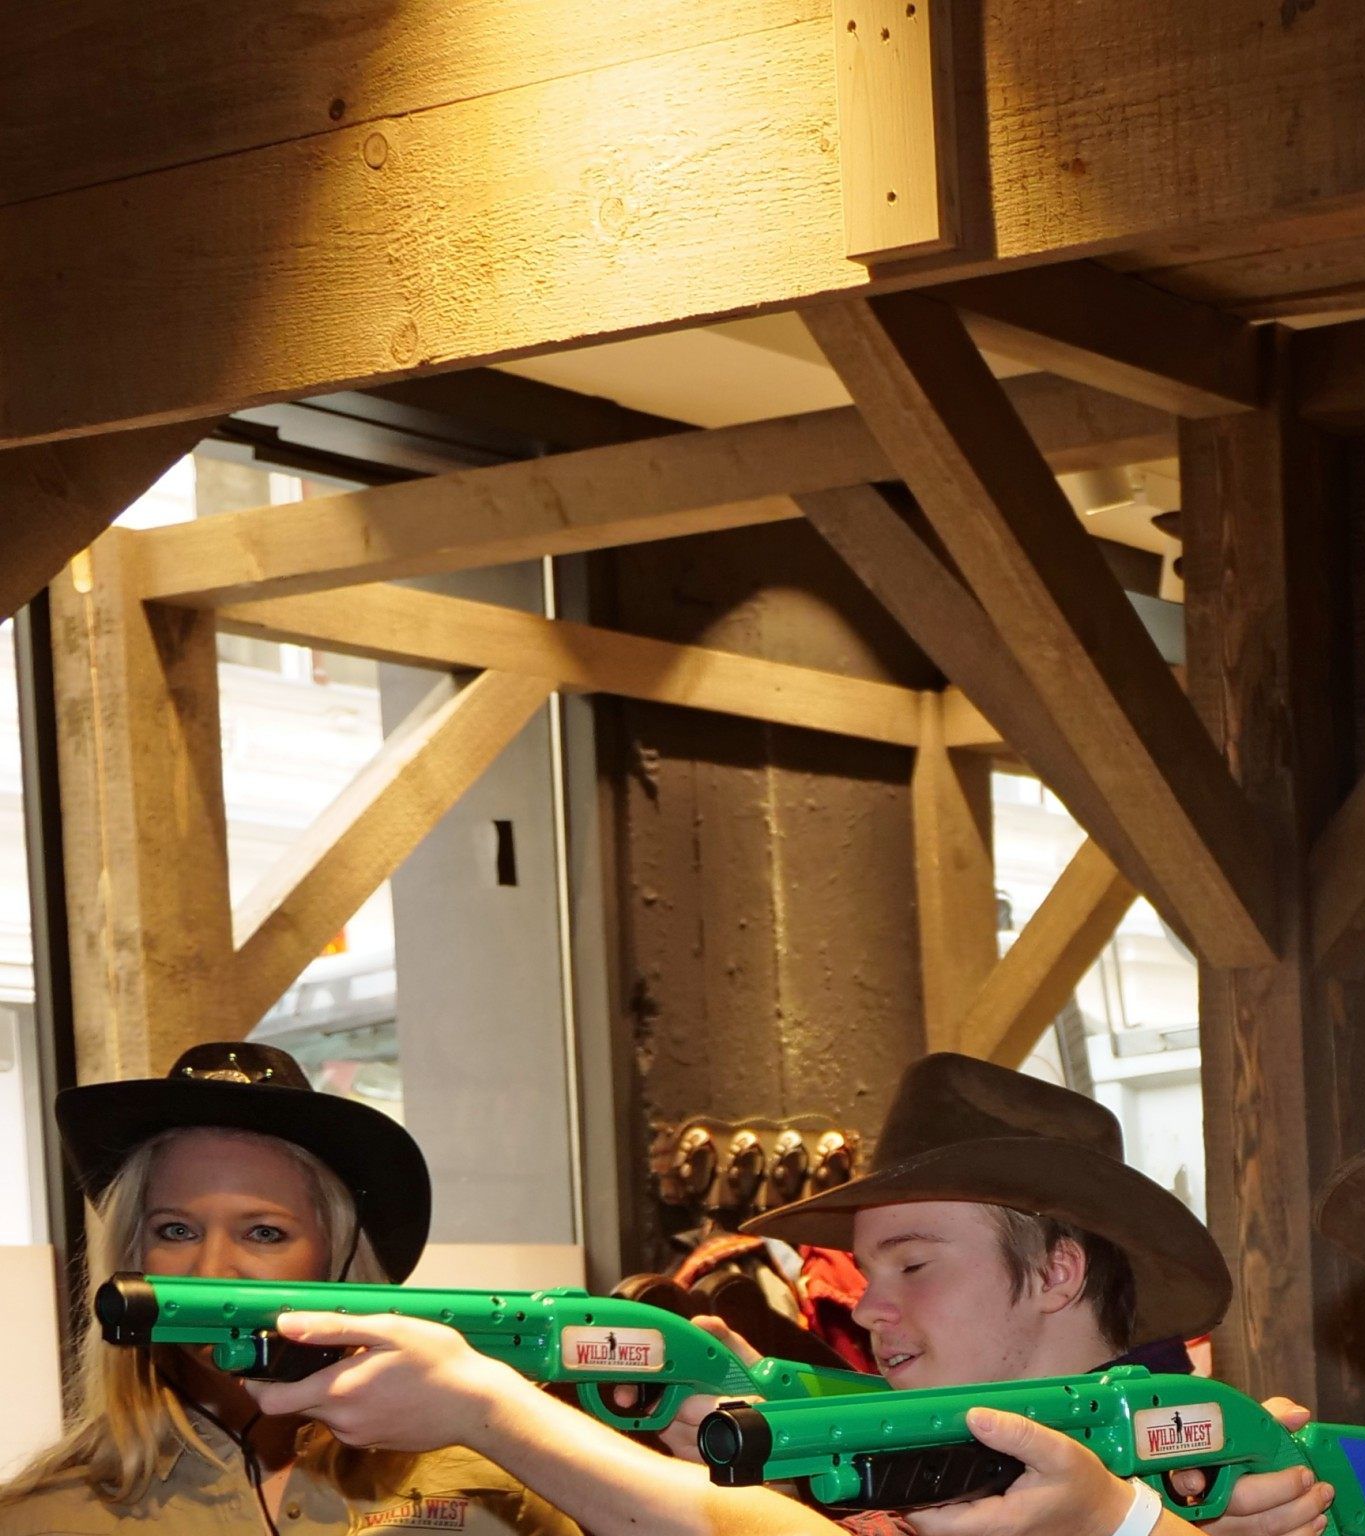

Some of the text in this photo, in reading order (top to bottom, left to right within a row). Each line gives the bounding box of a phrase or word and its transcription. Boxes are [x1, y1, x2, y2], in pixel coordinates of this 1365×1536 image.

[576, 1344, 651, 1366] WILD WEST
[1147, 1423, 1212, 1453] WILD WEST
[425, 1498, 468, 1527] WEST
